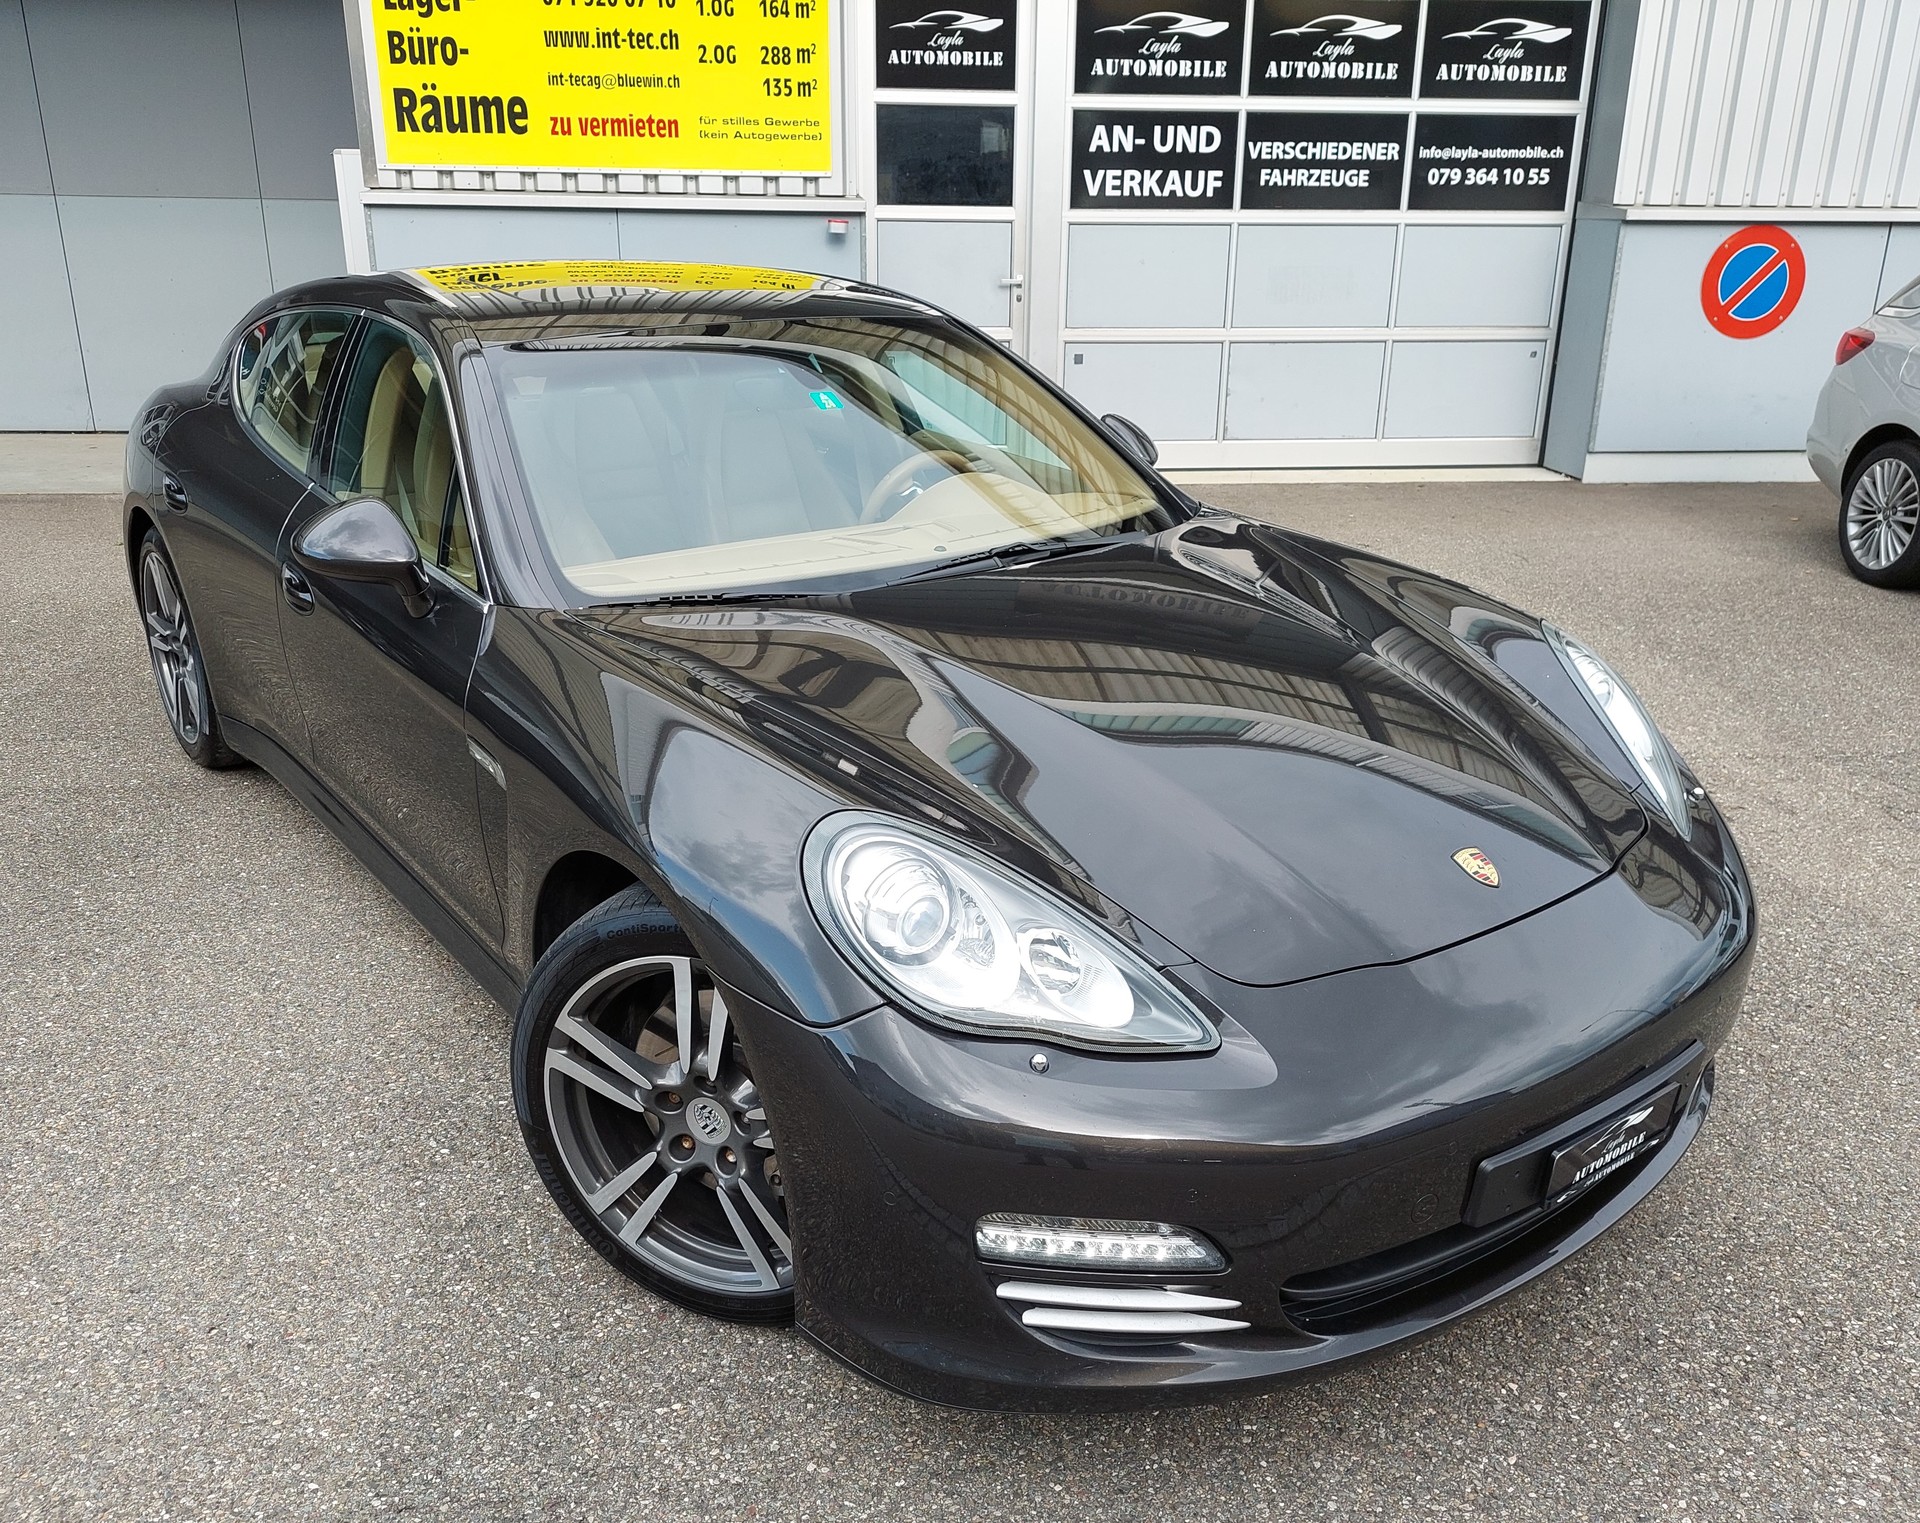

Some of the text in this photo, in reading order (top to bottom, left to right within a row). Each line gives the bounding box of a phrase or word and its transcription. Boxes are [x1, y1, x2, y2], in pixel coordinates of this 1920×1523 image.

[759, 0, 790, 18] 164
[387, 26, 469, 66] Büro-
[543, 27, 680, 50] www.int-tec.ch
[927, 30, 964, 50] Layla
[1138, 35, 1182, 60] Layla
[760, 46, 792, 66] 288
[888, 50, 1004, 67] AUTOMOBILE
[1312, 38, 1355, 62] Layla
[1482, 41, 1525, 65] Layla
[1090, 57, 1228, 78] AUTOMOBILE
[1265, 60, 1399, 81] AUTOMOBILE
[1435, 63, 1568, 83] AUTOMOBILE
[547, 72, 681, 90] int-tecag@bluewin.ch
[762, 78, 793, 97] 135
[393, 83, 529, 135] Räume
[550, 113, 680, 138] zu vermieten
[699, 116, 820, 127] für stilles Gewerbe
[699, 130, 822, 142] (kein Autogewerbe)
[1088, 125, 1222, 154] AN- UND
[1248, 141, 1400, 161] VERSCHIEDENER
[1418, 145, 1565, 162] info@layla-automobile.ch
[1083, 169, 1224, 198] VERKAUF
[1259, 168, 1370, 188] FAHRZEUGE
[1427, 167, 1551, 186] 079 364 10 55
[1571, 1131, 1647, 1185] AUTOMOBILE
